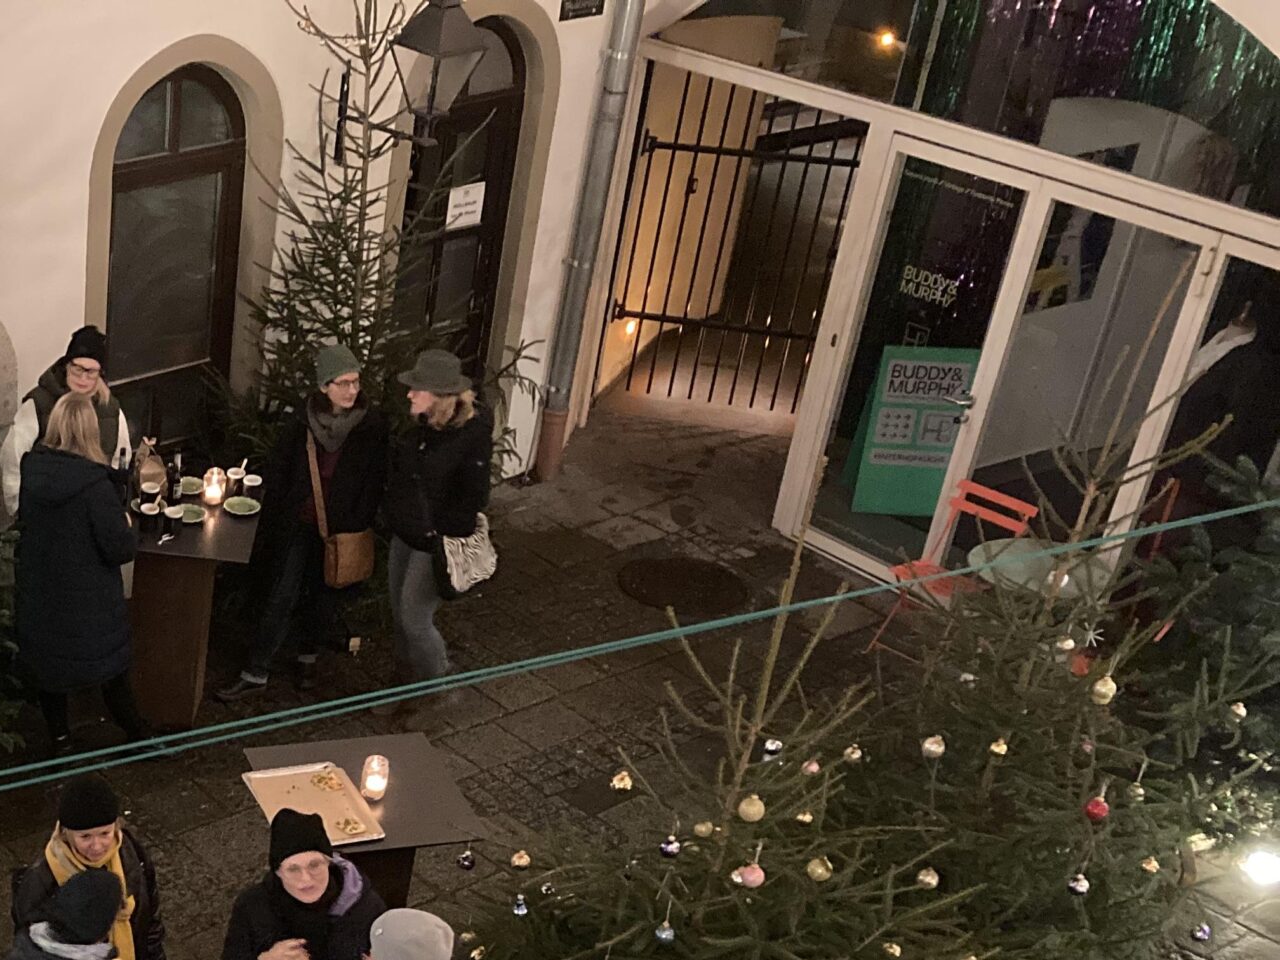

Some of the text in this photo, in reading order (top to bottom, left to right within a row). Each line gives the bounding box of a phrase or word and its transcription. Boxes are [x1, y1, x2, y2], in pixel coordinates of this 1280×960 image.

[900, 279, 956, 308] MURPHY
[891, 363, 963, 382] BUDDY&
[887, 380, 962, 396] MURPHY
